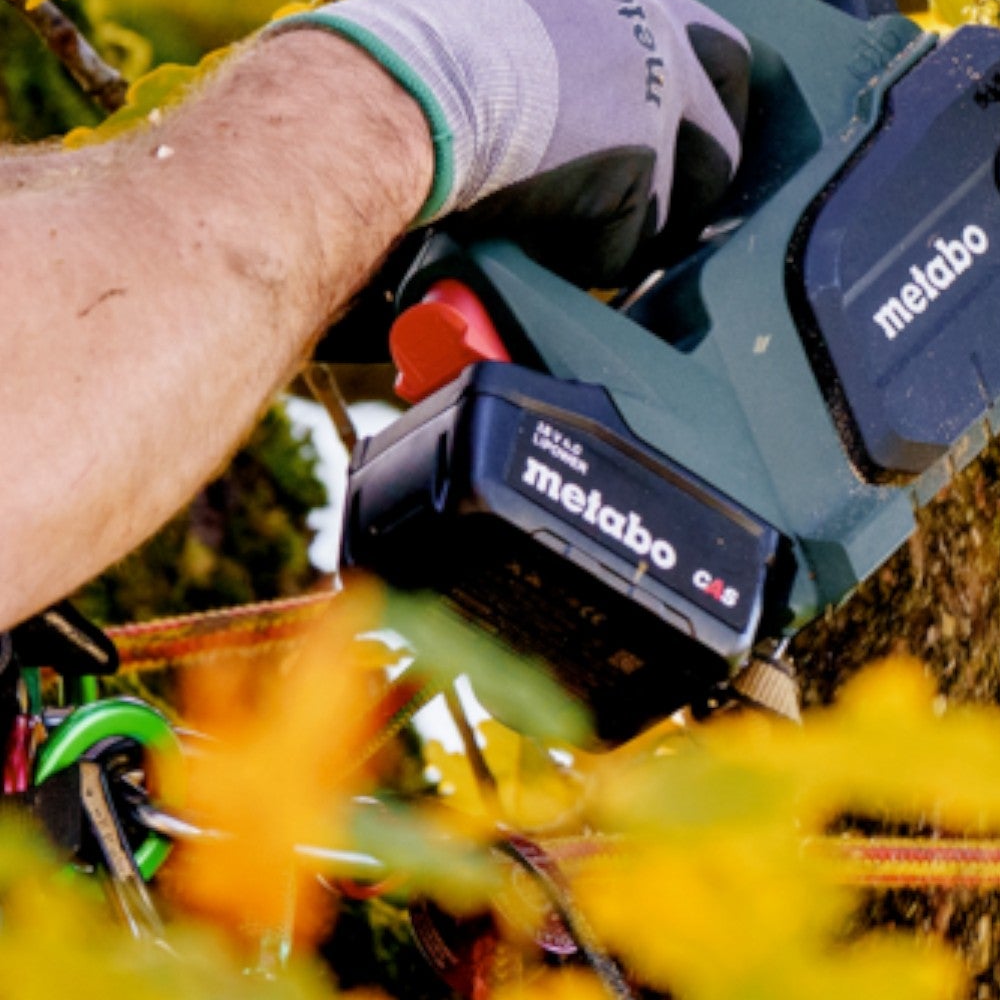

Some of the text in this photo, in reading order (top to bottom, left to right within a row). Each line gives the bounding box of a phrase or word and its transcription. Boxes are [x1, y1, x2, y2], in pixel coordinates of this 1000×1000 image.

[873, 224, 989, 341] metabo
[521, 456, 677, 570] metabo
[692, 569, 740, 607] CAS
